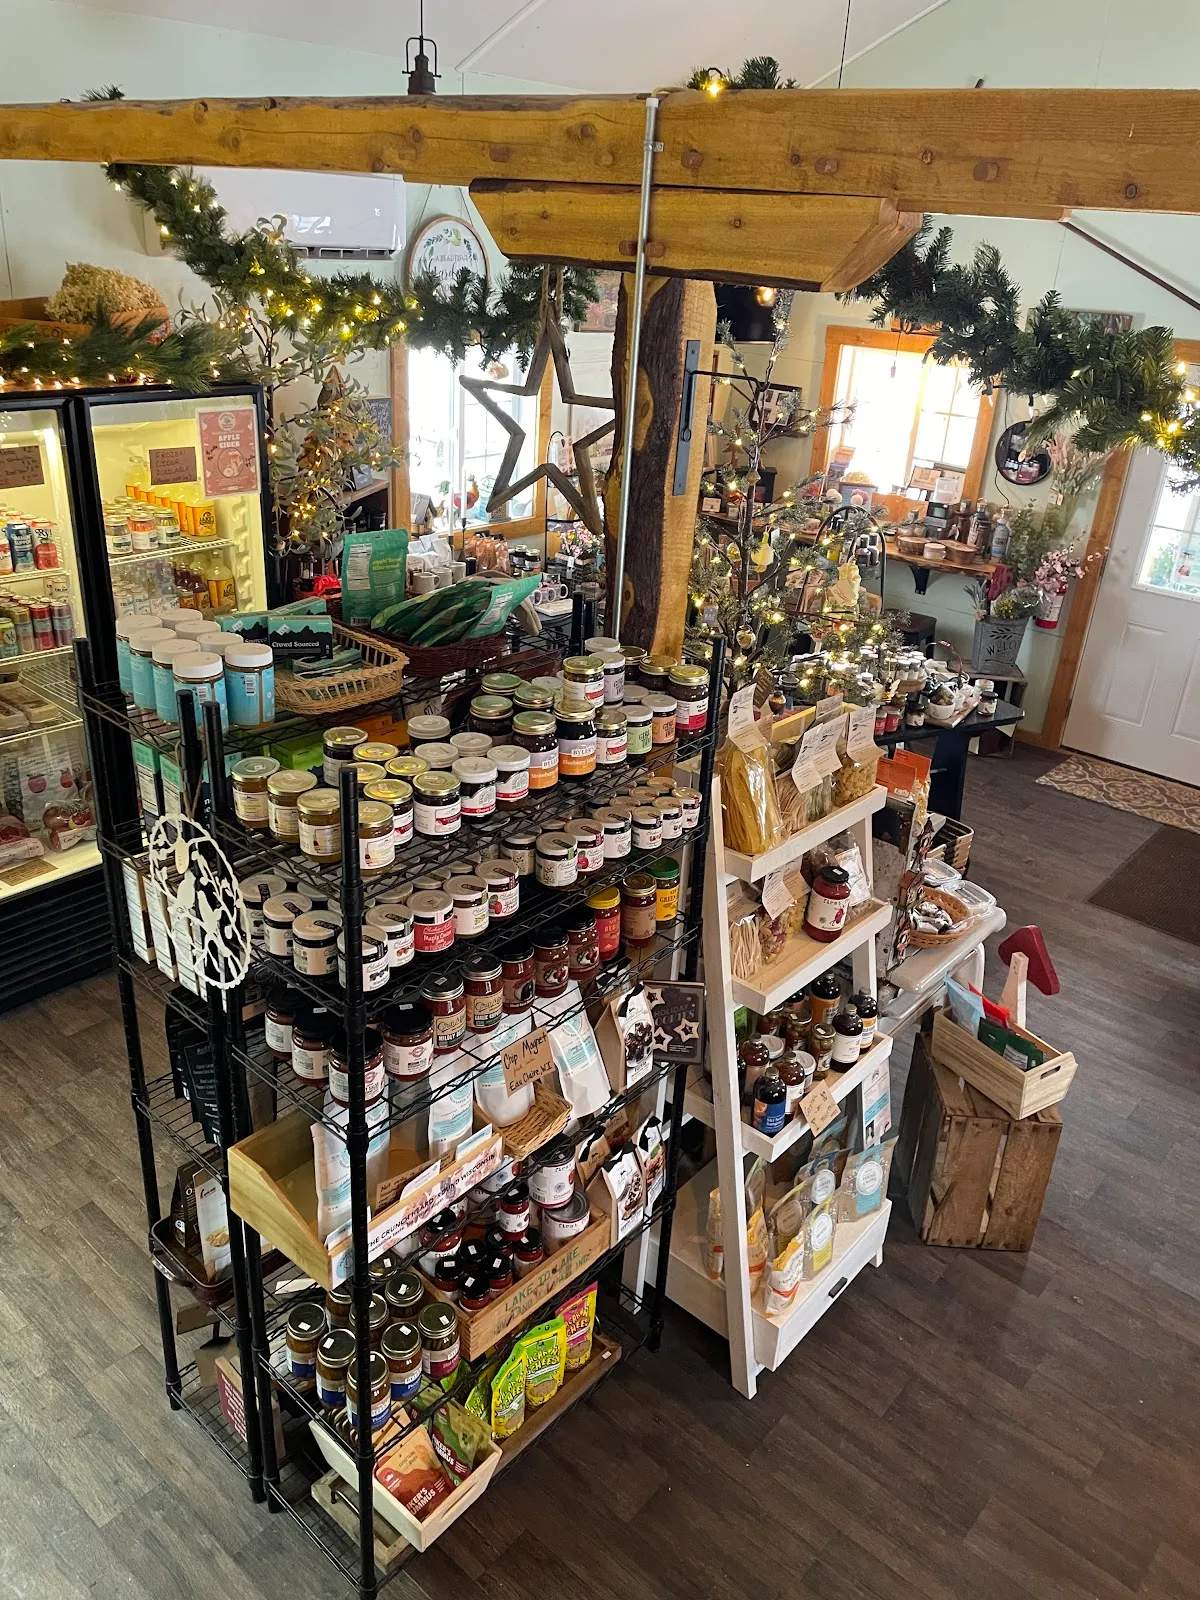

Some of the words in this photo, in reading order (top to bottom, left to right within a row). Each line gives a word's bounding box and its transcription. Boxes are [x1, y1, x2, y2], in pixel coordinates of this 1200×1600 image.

[522, 1032, 548, 1058] Magnet
[381, 1213, 411, 1239] CRUNCH
[461, 1153, 496, 1182] WISCONSIN
[406, 1486, 429, 1511] IKER'S
[410, 1488, 437, 1515] UMMUS
